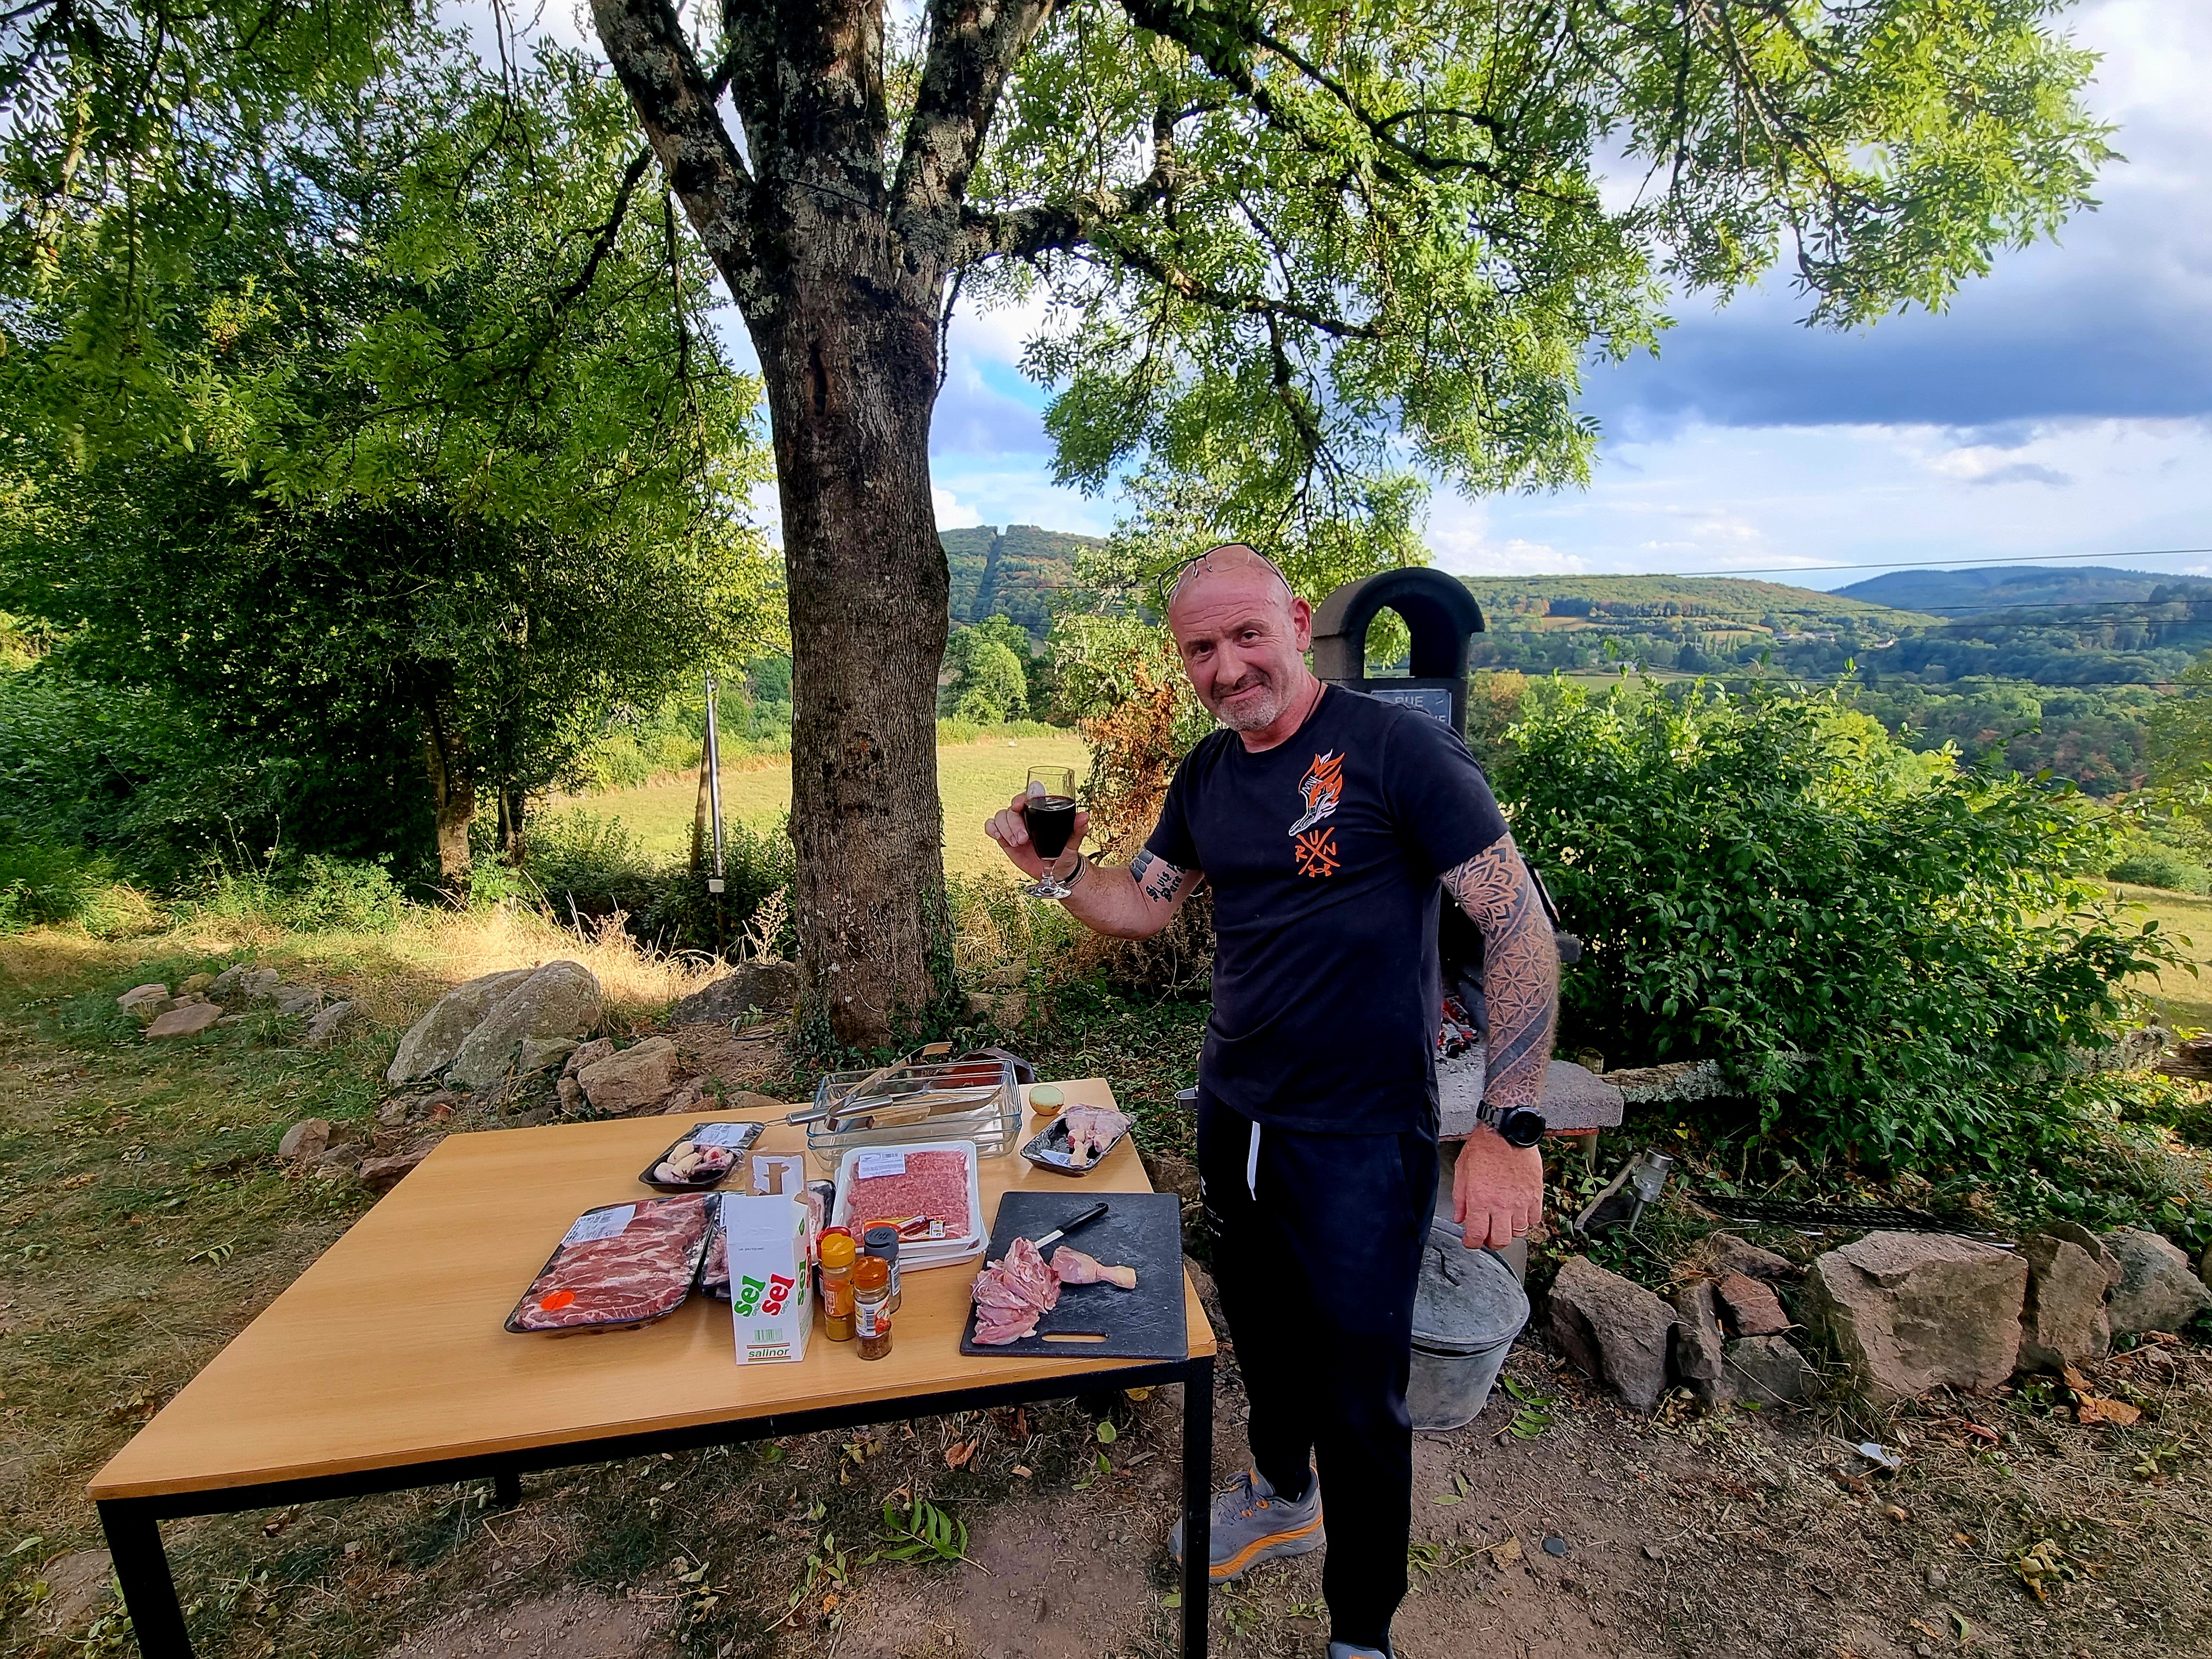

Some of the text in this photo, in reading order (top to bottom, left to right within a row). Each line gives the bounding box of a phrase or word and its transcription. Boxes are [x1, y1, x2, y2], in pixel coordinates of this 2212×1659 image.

[1395, 696, 1424, 708] RUE
[1295, 830, 1337, 862] RUN
[748, 1348, 789, 1358] salinor
